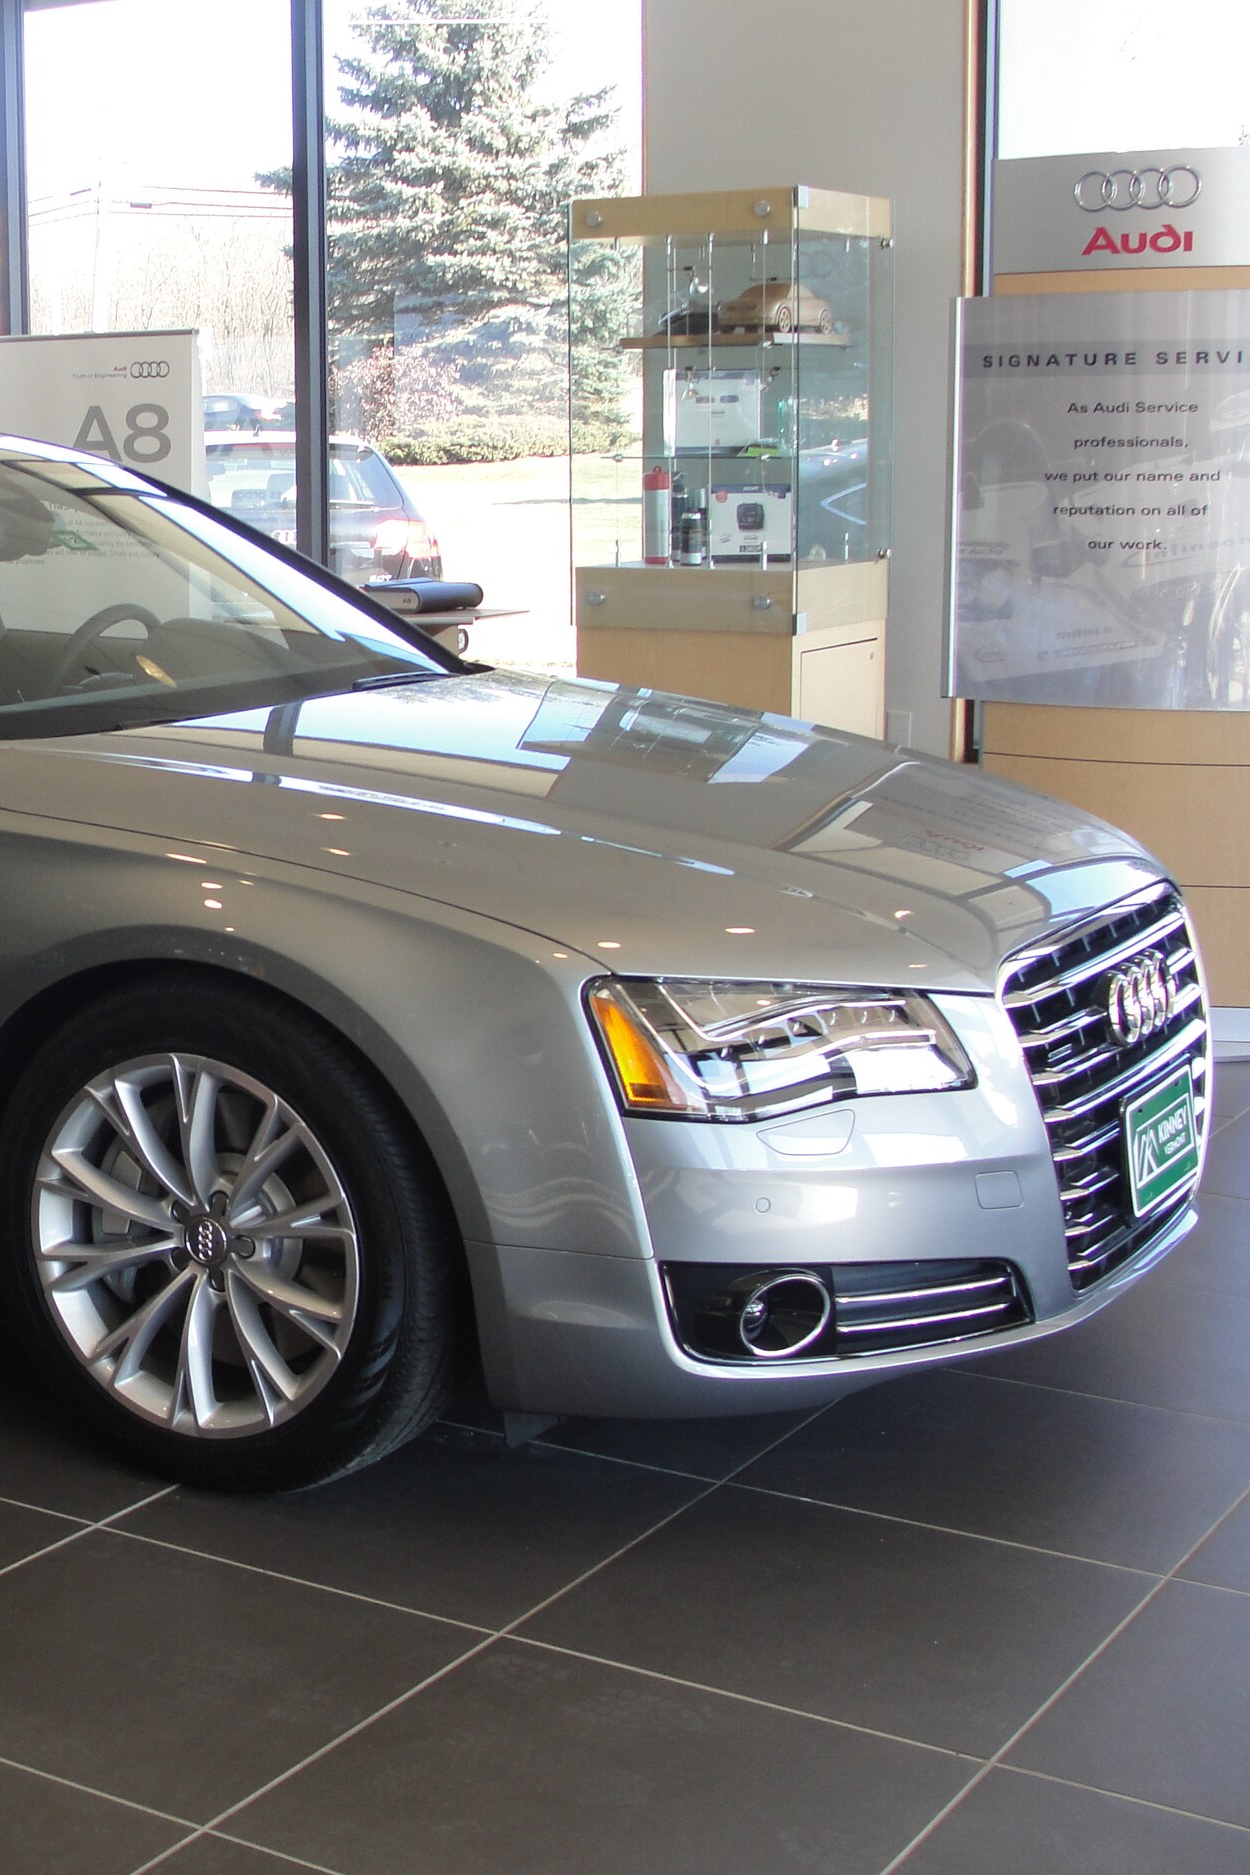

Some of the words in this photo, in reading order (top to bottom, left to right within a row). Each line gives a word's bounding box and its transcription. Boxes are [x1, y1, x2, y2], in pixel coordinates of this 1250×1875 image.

[1081, 223, 1194, 256] Audi
[982, 351, 1137, 368] SIGNATURE
[1154, 350, 1250, 365] SERVI
[1066, 401, 1089, 414] As
[1093, 401, 1130, 414] Audi
[1134, 400, 1199, 414] Service
[73, 403, 171, 463] A8
[1073, 435, 1190, 450] professionals,
[1043, 472, 1068, 482] we
[1072, 470, 1099, 485] put
[1103, 472, 1132, 482] our
[1135, 472, 1184, 482] name
[1188, 469, 1221, 482] and
[1052, 503, 1136, 519] reputation
[1140, 507, 1162, 517] on
[1166, 503, 1186, 517] all
[1189, 503, 1209, 517] of
[1087, 540, 1115, 550] our
[1119, 537, 1168, 551] work.
[1158, 1106, 1187, 1143] KINNEY
